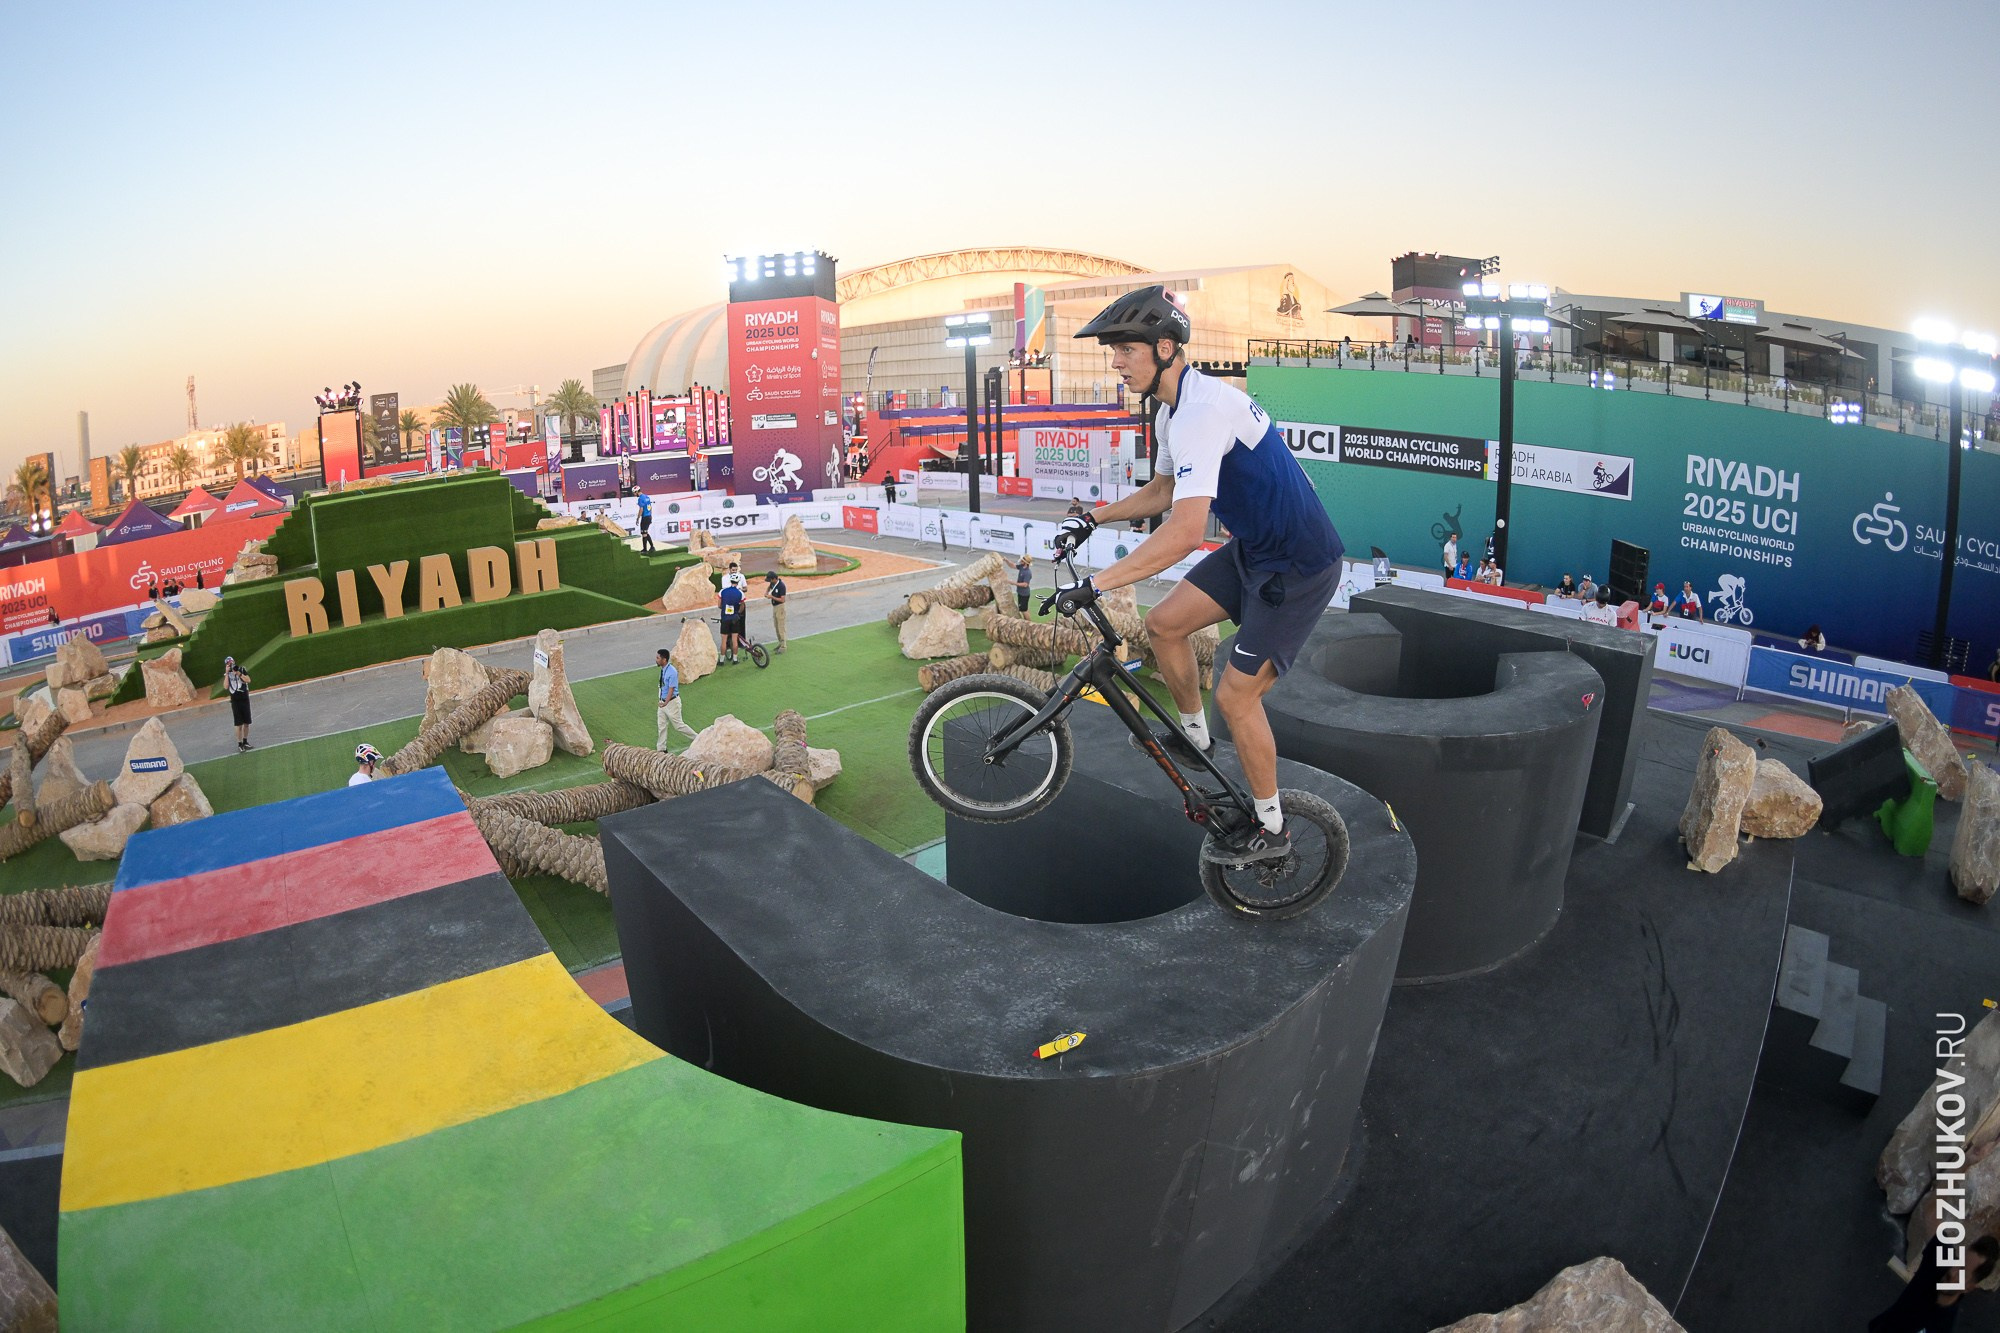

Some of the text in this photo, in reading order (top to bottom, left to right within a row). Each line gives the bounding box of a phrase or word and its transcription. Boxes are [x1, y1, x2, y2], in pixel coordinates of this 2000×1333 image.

[1725, 298, 1757, 308] RIYADH
[745, 310, 798, 327] RIYADH
[745, 325, 799, 339] 2025 UCI
[746, 343, 799, 352] CHAMPIONSHIPS
[1035, 431, 1089, 449] RIYADH
[1287, 428, 1335, 455] UCI
[1344, 433, 1459, 455] 2025 URBAN CYCLING
[1035, 447, 1090, 462] 2025 UCI
[1344, 446, 1482, 473] WORLD CHAMPIONSHIPS
[1494, 448, 1535, 464] RADH
[1035, 467, 1090, 478] CHAMPIONSHIPS
[1494, 463, 1572, 484] SUDI ARABIA
[1686, 453, 1800, 503] RIYADH
[694, 514, 760, 530] TISSOT
[1683, 492, 1798, 536] 2025 UCI
[1682, 521, 1795, 552] URBAN CYCLING WORLD
[1915, 524, 1962, 550] SAUI
[1680, 536, 1793, 568] CHAMPIONSHIPS
[160, 557, 224, 577] SAUDI CYCLING
[1377, 561, 1387, 575] 4
[0, 577, 46, 601] RIYADH
[284, 538, 560, 637] RIYADH
[1, 594, 48, 615] 2025 UCI
[1677, 643, 1710, 664] UCI
[1790, 664, 1896, 704] SHIMAN
[131, 760, 167, 770] SHIMANO
